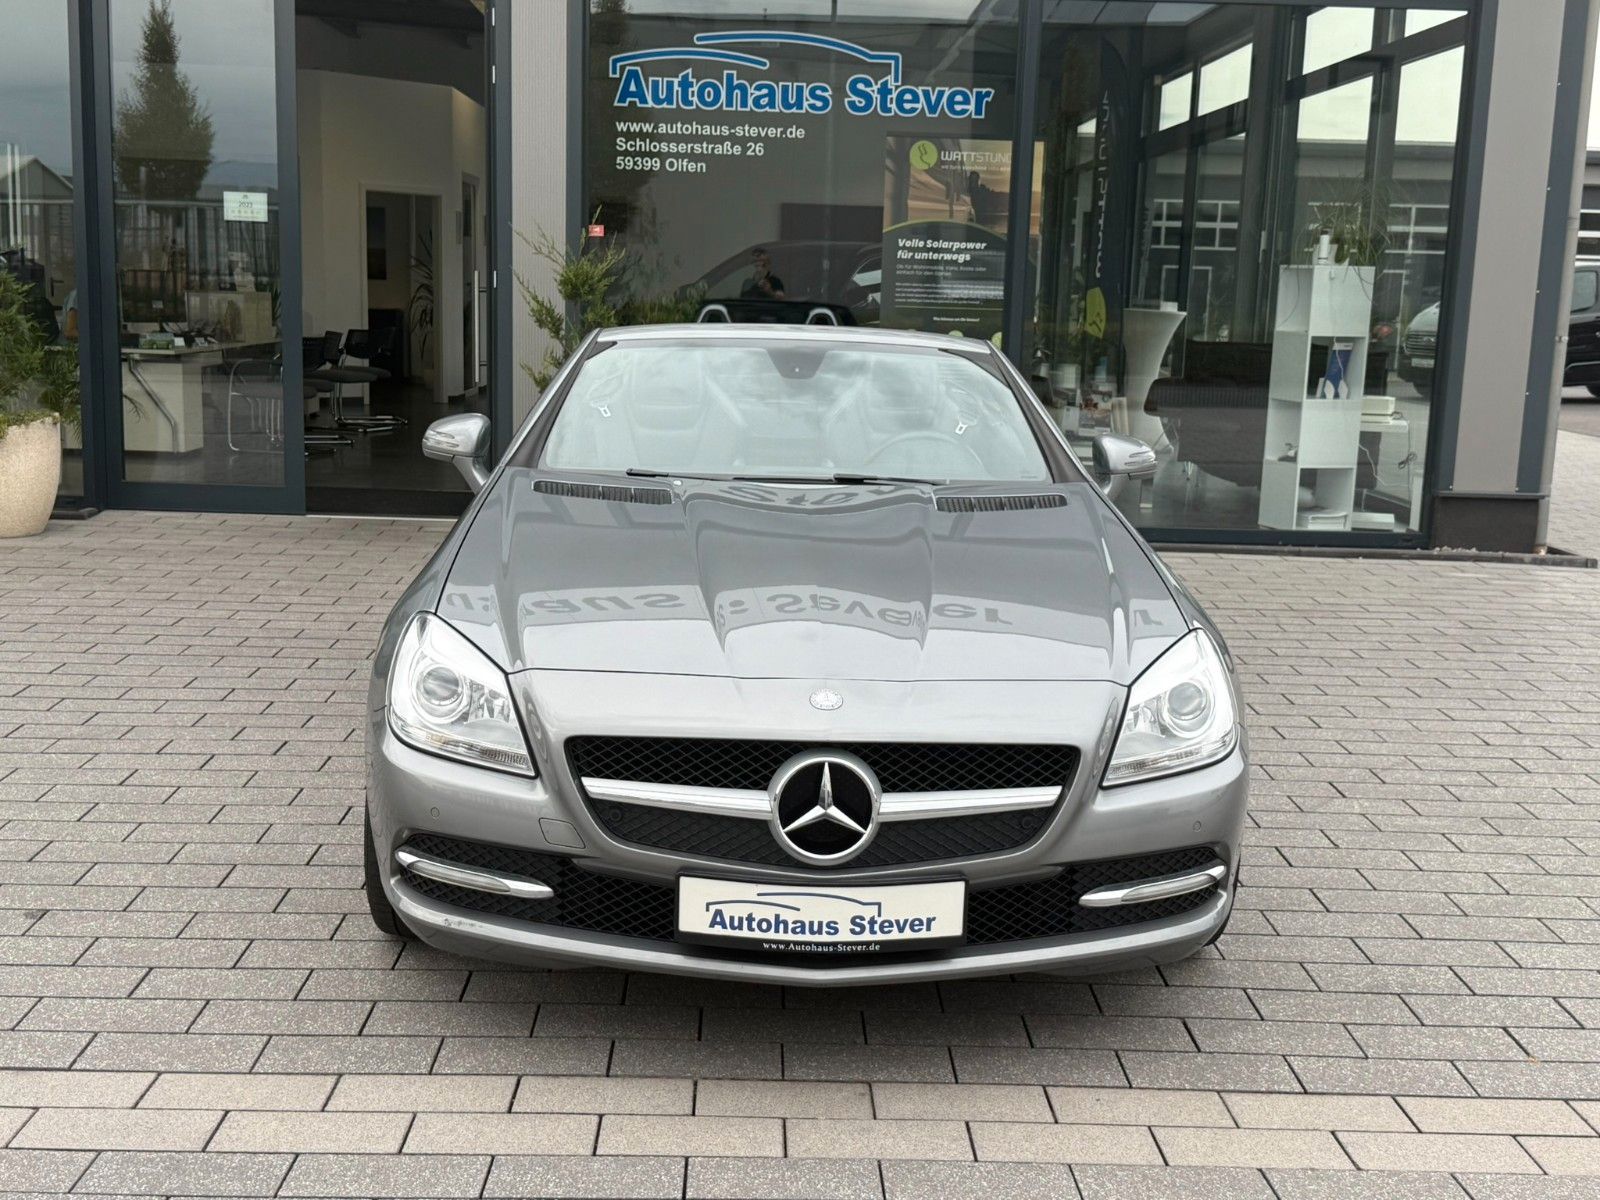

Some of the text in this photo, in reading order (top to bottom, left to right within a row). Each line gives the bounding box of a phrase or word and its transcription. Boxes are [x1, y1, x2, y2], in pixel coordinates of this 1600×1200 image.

[613, 66, 995, 119] Autohaus Stever
[615, 121, 805, 139] www.autohaus-stever.de
[616, 138, 764, 156] Schlosserstraße 26
[616, 156, 707, 173] 59399 Olfen
[898, 239, 987, 251] Volle Solarpower
[897, 250, 971, 263] für unterwegs
[708, 908, 936, 935] Autohaus Stever
[762, 941, 881, 952] www.Autohaus-Stever.de
